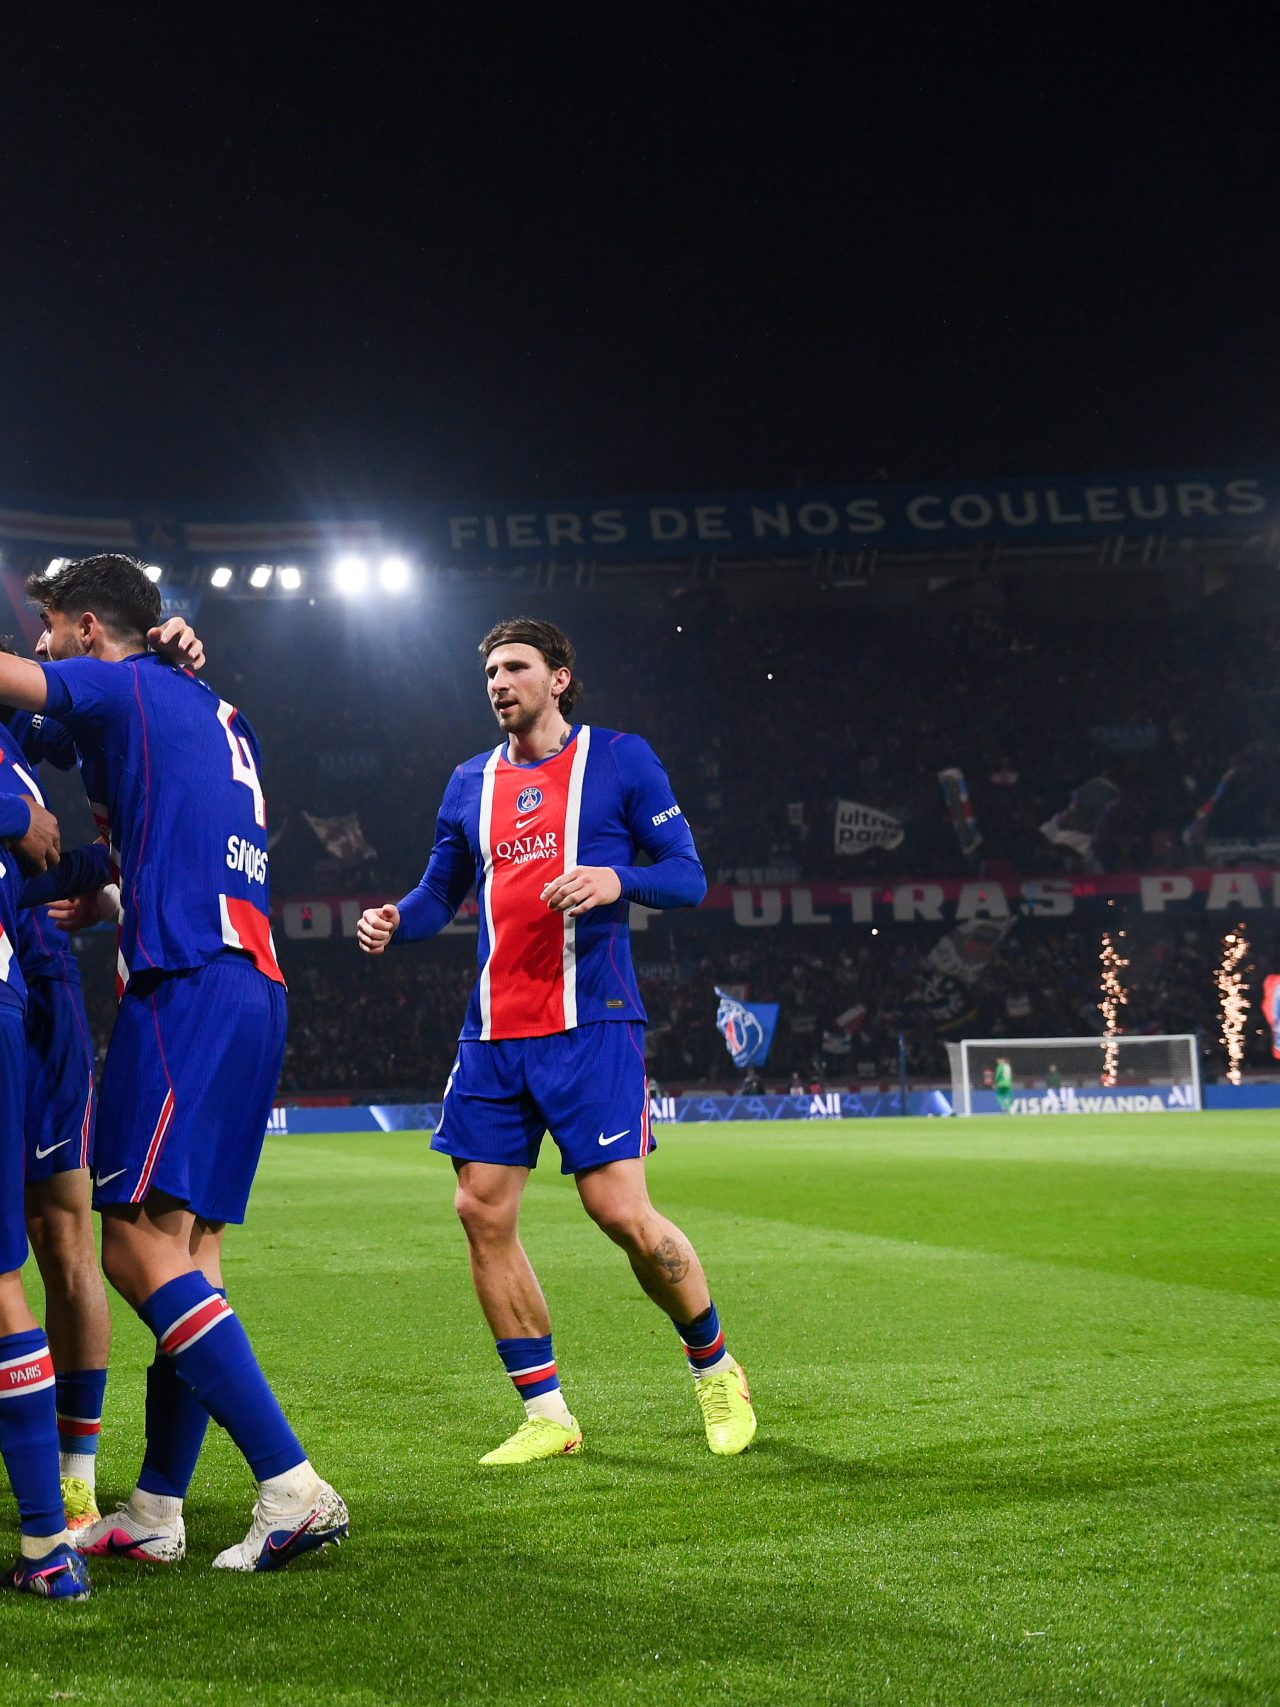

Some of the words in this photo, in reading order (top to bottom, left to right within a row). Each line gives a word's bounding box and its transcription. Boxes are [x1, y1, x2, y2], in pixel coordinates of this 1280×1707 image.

[448, 508, 629, 551] FIERS
[648, 504, 733, 541] DE
[751, 497, 886, 537] NOS
[905, 478, 1267, 531] COULEURS
[216, 698, 267, 830] 4
[226, 834, 269, 885] snipes
[496, 832, 558, 859] QATAR
[512, 847, 558, 866] AIRWAYS
[732, 878, 1075, 927] ULTRAS
[1140, 871, 1280, 912] PA
[9, 1363, 42, 1384] PARIS
